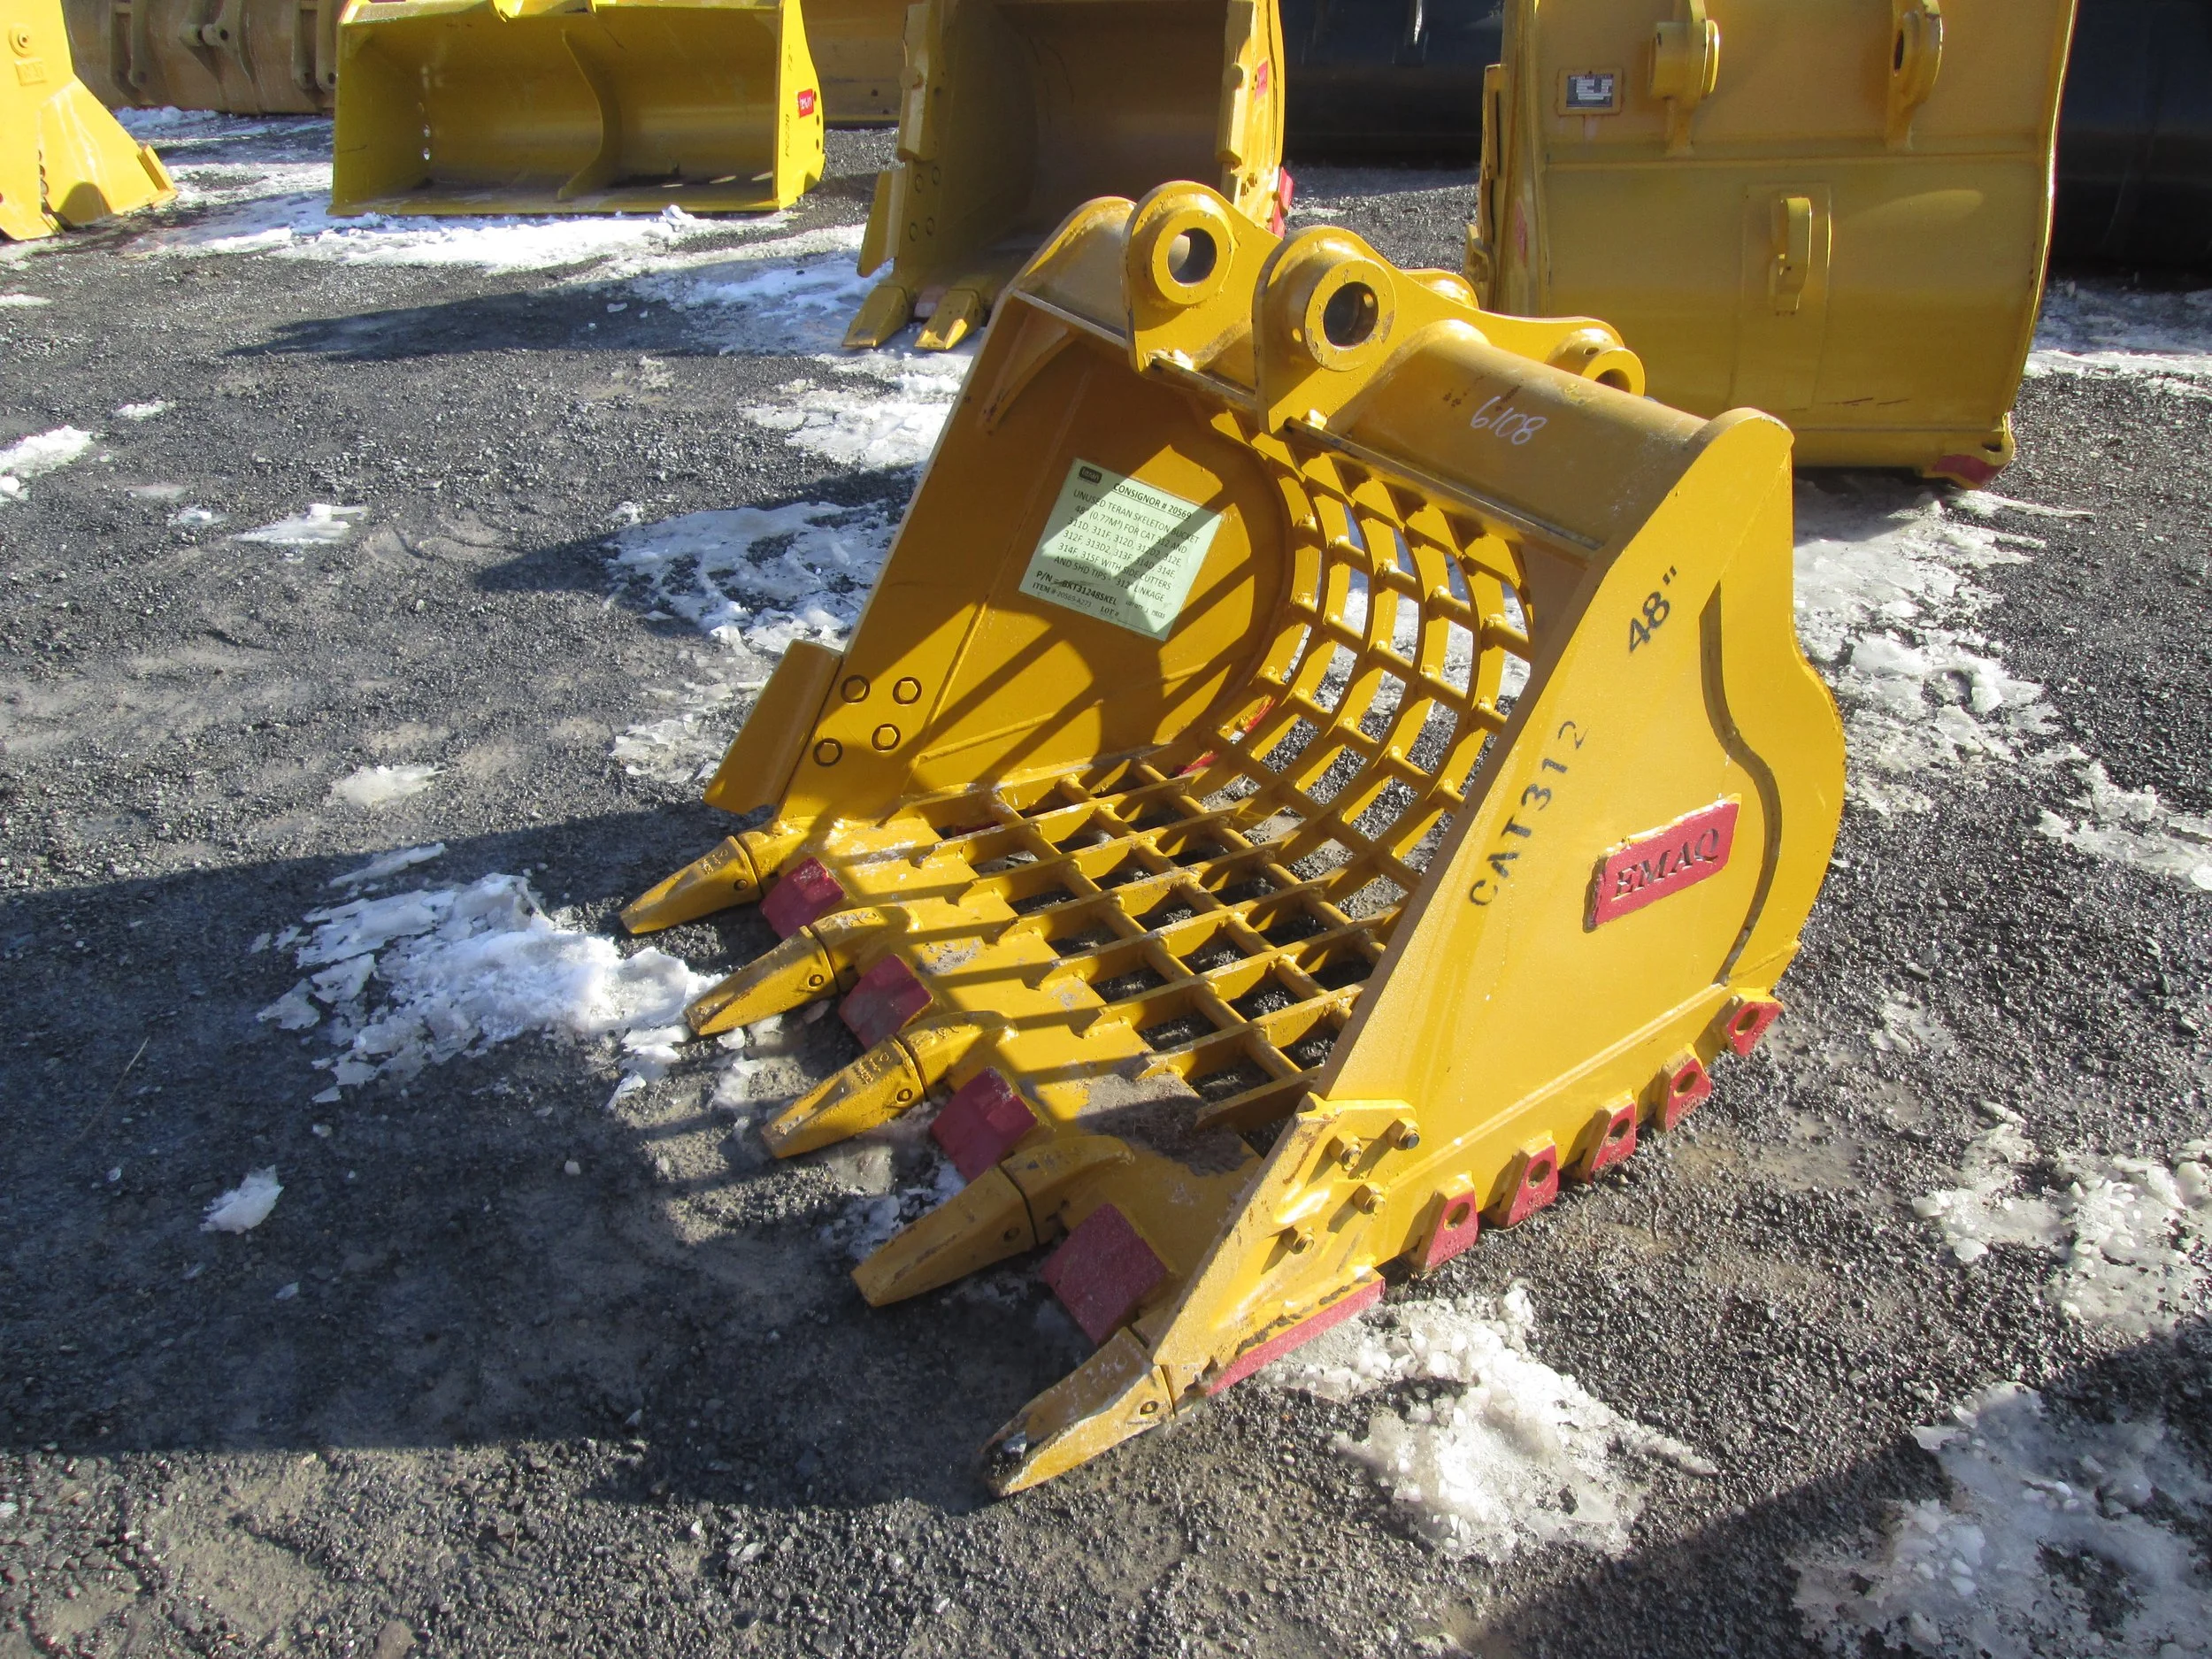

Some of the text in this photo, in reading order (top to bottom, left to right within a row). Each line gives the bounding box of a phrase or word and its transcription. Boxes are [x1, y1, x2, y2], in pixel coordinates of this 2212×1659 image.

[1471, 396, 1548, 445] 6108
[1073, 488, 1200, 544] UNUSED TERAN SKELETON BUCKET
[1113, 482, 1192, 519] CONSIGNOR # 20569
[1063, 529, 1084, 545] 312F,
[1086, 538, 1111, 555] 313D2,
[1067, 516, 1090, 533] 311D,
[1091, 526, 1112, 541] 311F,
[1113, 534, 1134, 549] 312D,
[1124, 523, 1140, 537] FOR
[1141, 530, 1156, 542] CAT
[1156, 535, 1171, 548] 312
[1171, 541, 1187, 553] AND
[1032, 581, 1051, 594] ITEM
[1036, 571, 1054, 582] P/N
[1053, 557, 1072, 568] AND
[1091, 568, 1108, 581] TIPS
[1133, 584, 1166, 603] LINKAGE
[1080, 550, 1101, 564] 315F
[1101, 557, 1123, 572] WITH
[1121, 566, 1140, 579] SIDE
[1140, 572, 1172, 591] CUTTERS
[1627, 565, 1678, 654] 48"
[1610, 827, 1721, 903] EMAQ
